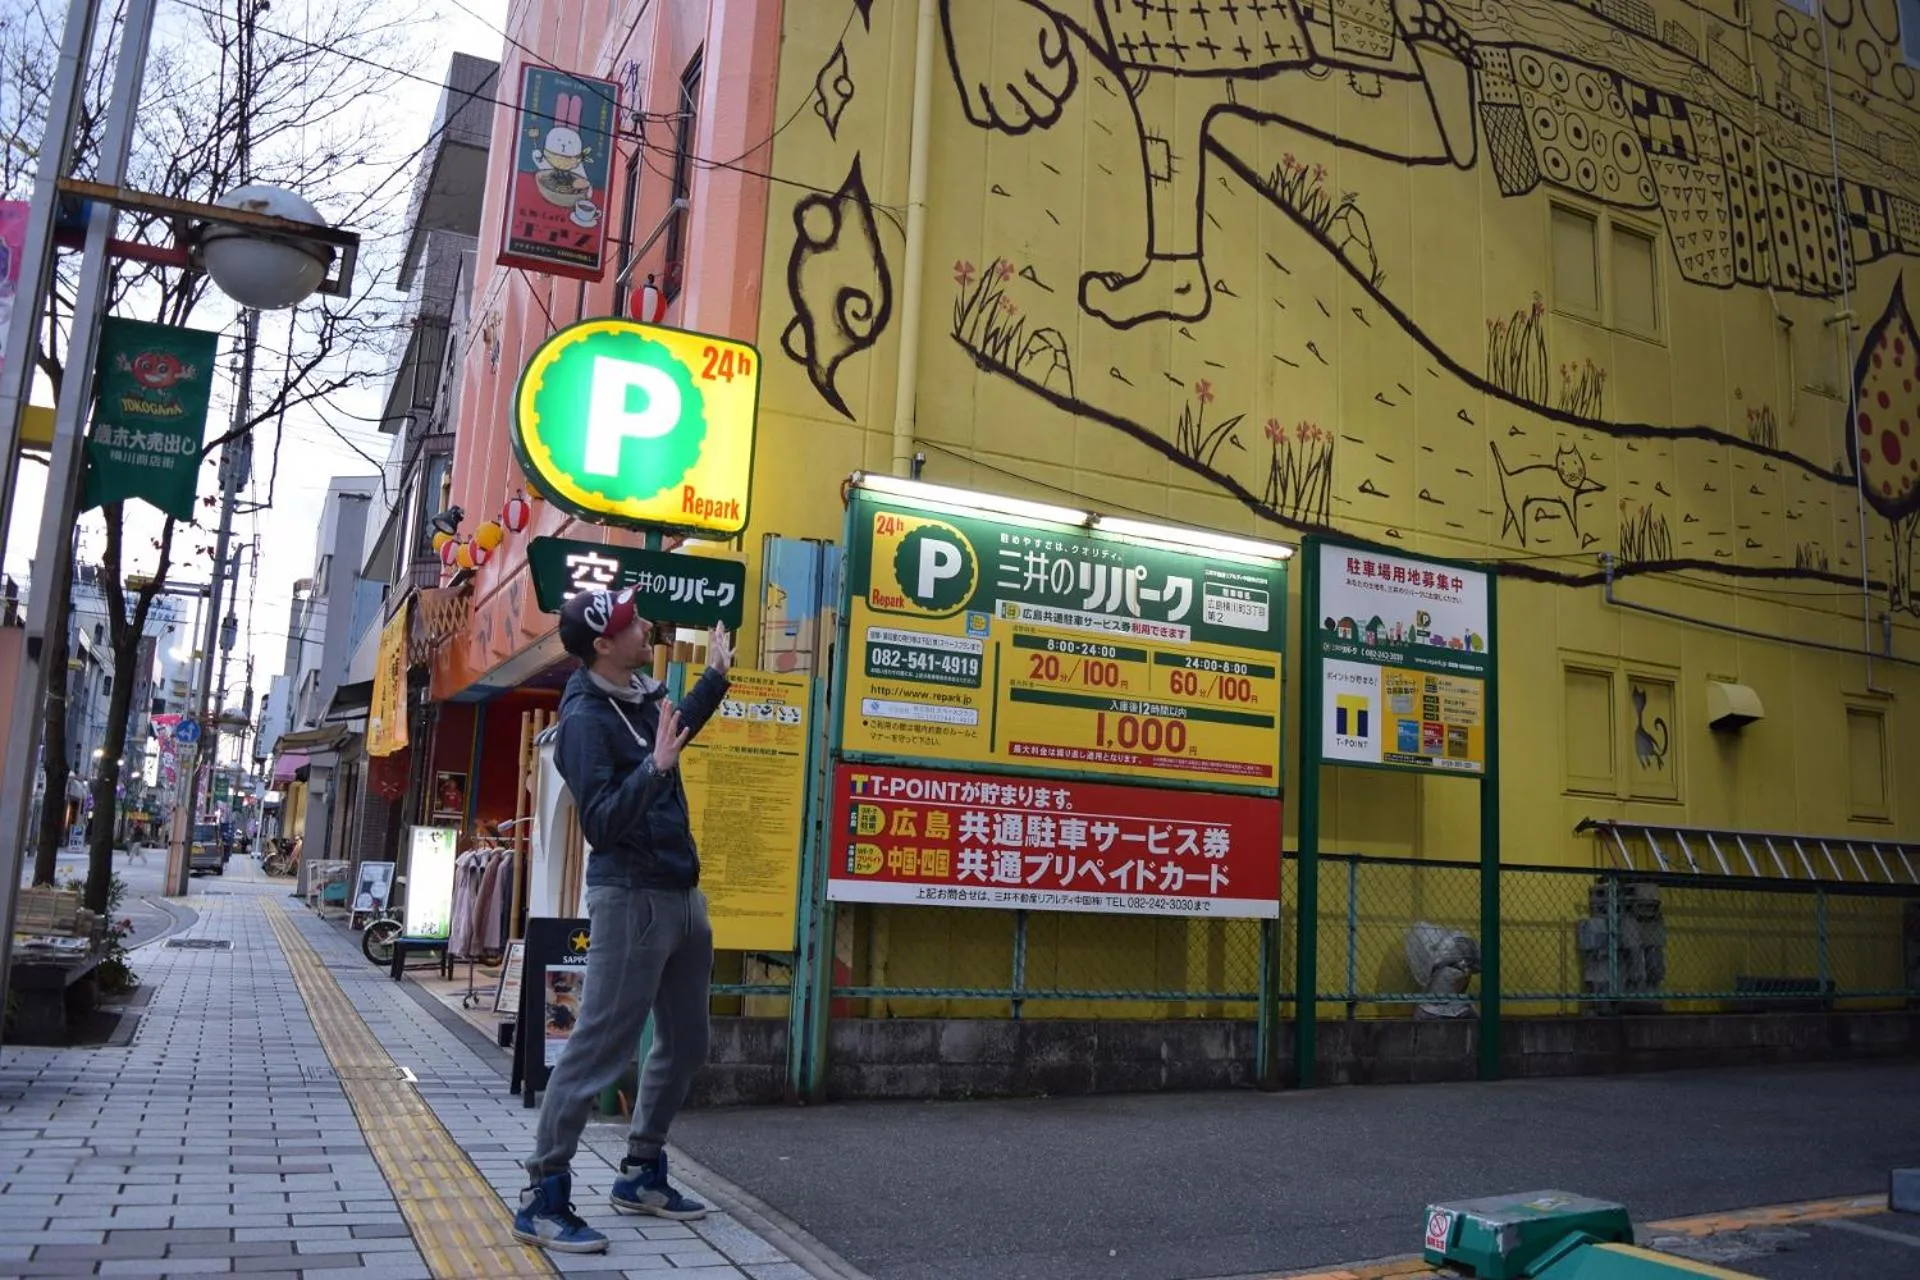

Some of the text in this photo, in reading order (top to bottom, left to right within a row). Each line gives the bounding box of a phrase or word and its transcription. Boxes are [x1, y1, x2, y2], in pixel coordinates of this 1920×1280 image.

[702, 345, 751, 383] 24h
[583, 354, 682, 477] P
[682, 485, 740, 521] Repark
[876, 515, 905, 536] 24h
[918, 537, 962, 598] P
[997, 549, 1193, 622] 三井のリパーク
[1346, 556, 1464, 594] 駐車場用地募集中
[872, 588, 905, 609] Repark
[871, 647, 979, 676] 082-541-4919
[1047, 639, 1116, 658] 8:00-24:00
[871, 684, 973, 705] http://www.repark.jp
[870, 776, 1073, 810] T-POINTが貯まります。
[889, 807, 1230, 859] 広島 共通駐車サービス券
[887, 845, 951, 878] 中国・四国
[956, 848, 1230, 895] 共通プリペイドカード
[1106, 896, 1126, 908] TEL
[1127, 896, 1211, 911] 082-242-3030まで
